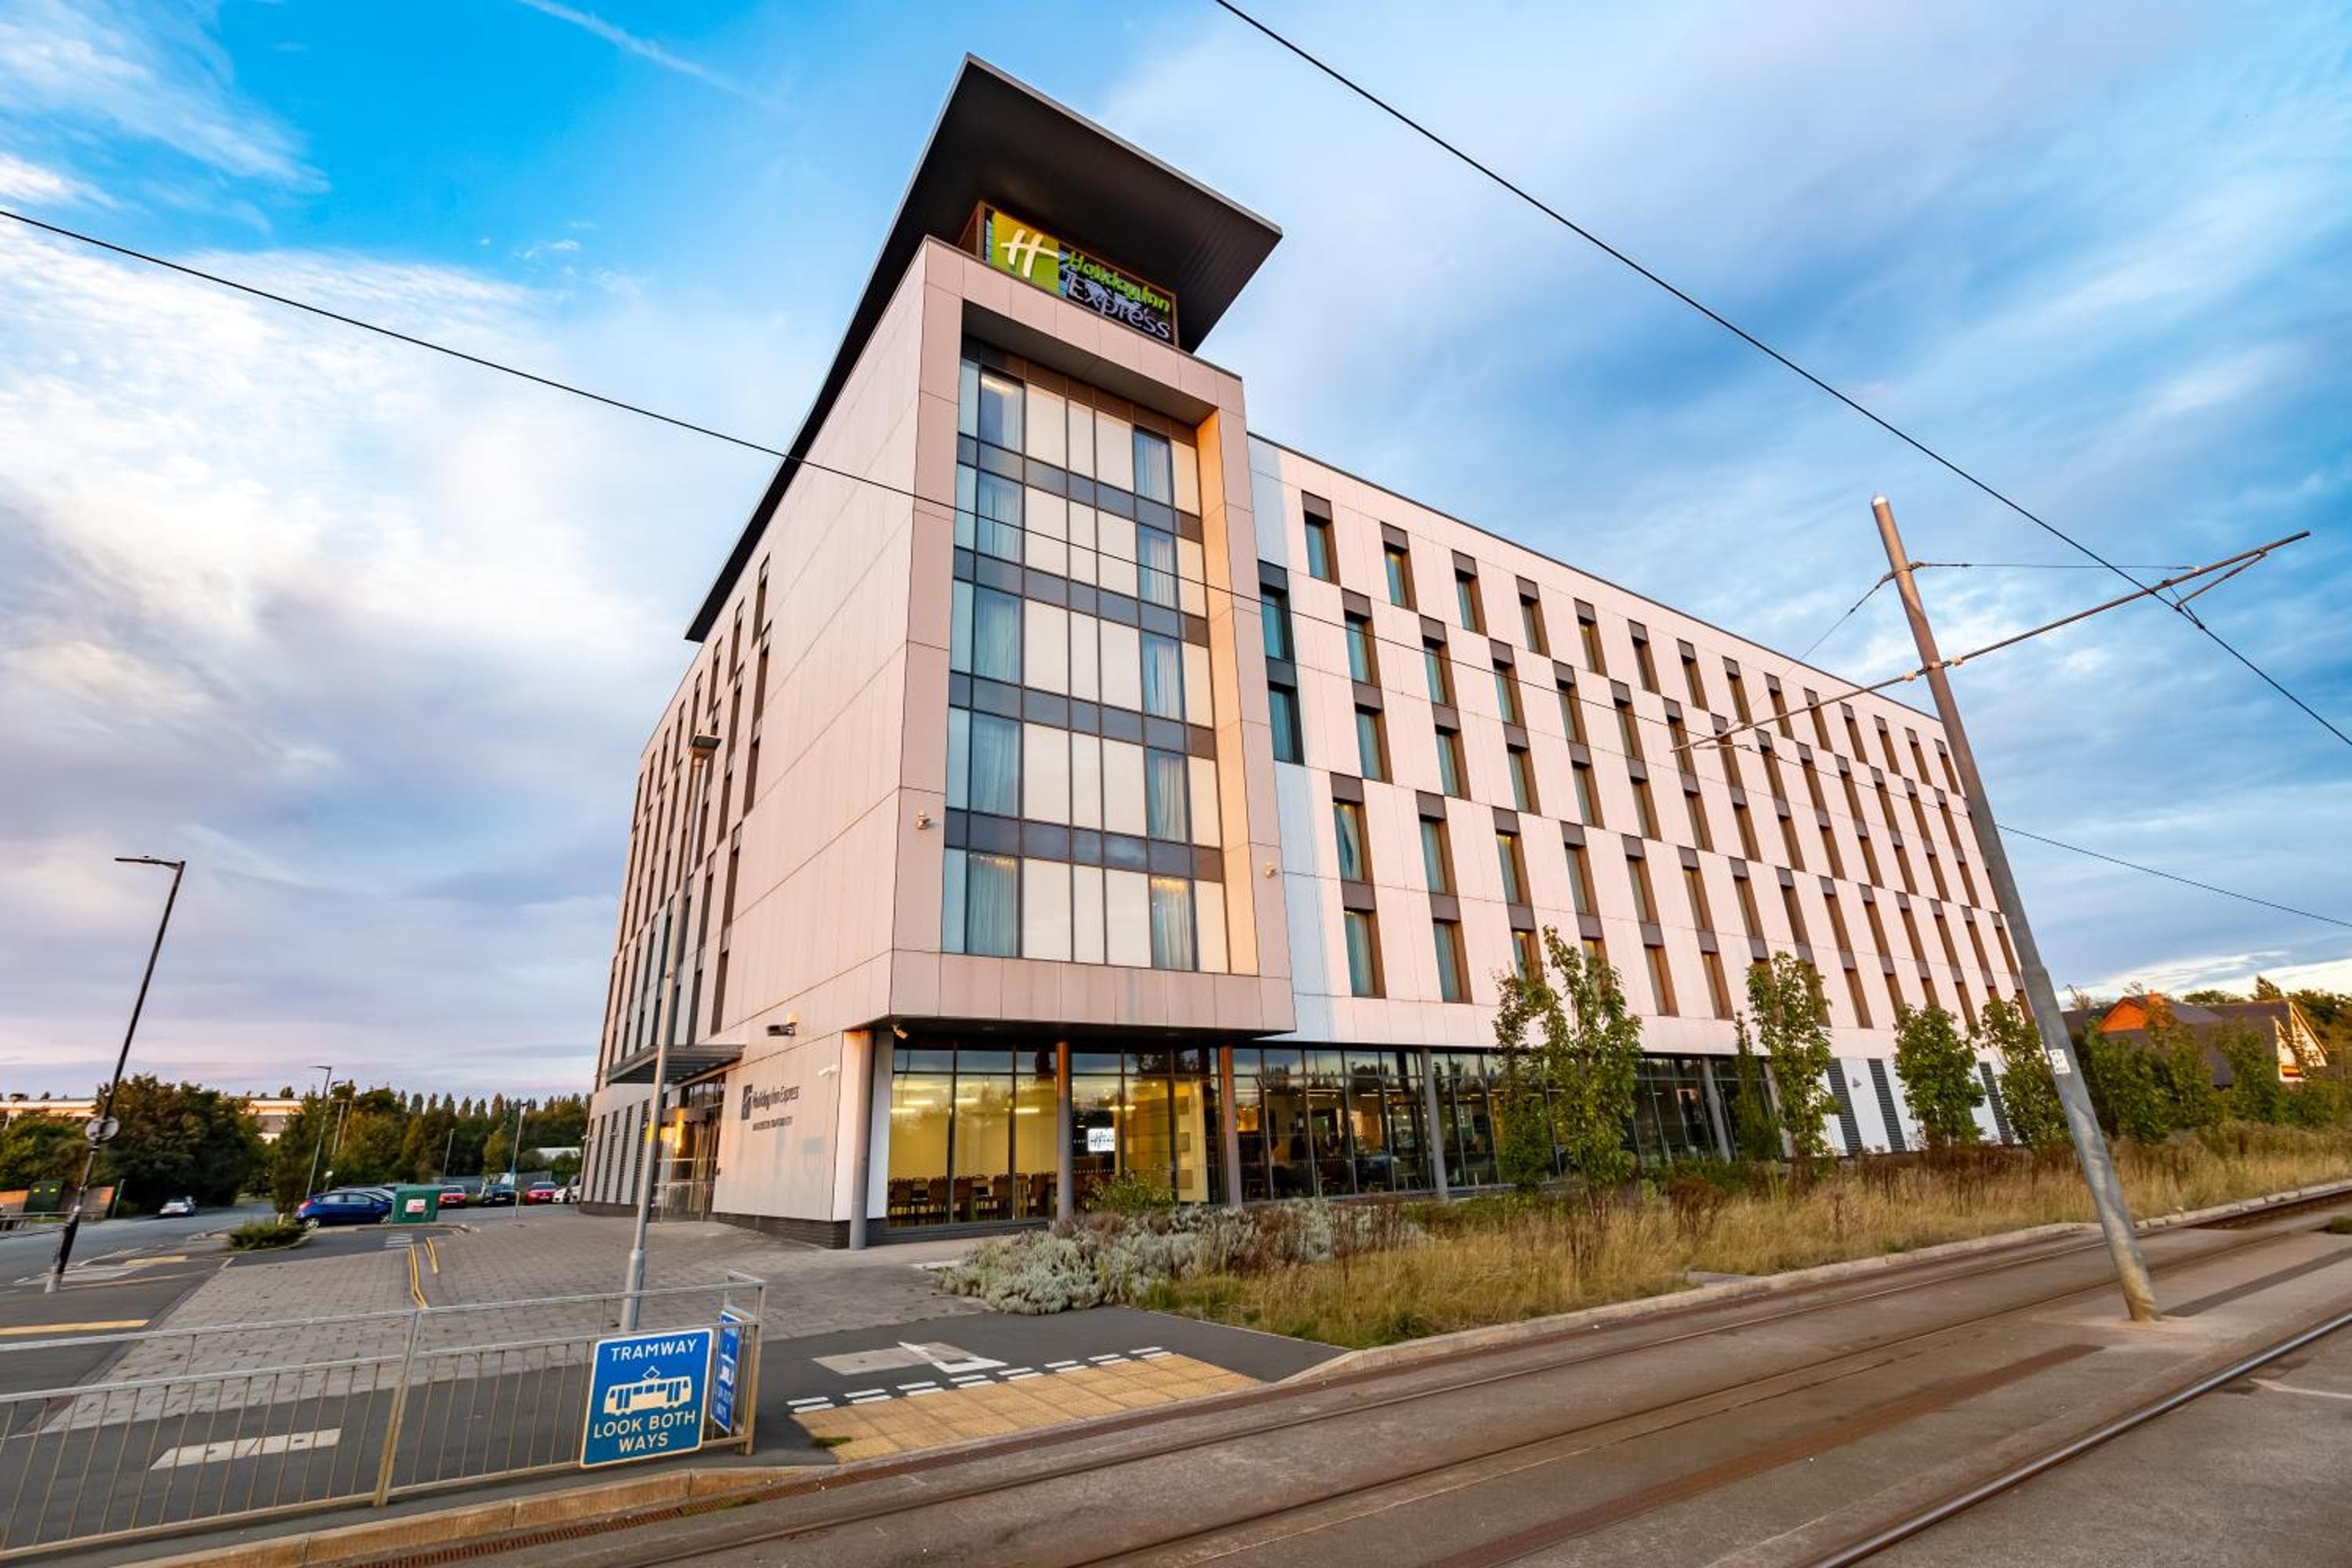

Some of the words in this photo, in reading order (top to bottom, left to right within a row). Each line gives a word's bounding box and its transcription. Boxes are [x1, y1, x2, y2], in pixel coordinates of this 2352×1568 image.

[1066, 250, 1141, 302] Holiday
[1141, 285, 1171, 312] Inn
[1067, 273, 1171, 339] Express
[610, 1338, 698, 1363] TRAMWAY
[593, 1417, 643, 1439] LOOK
[648, 1410, 696, 1431] BOTH
[619, 1432, 669, 1454] WAYS
